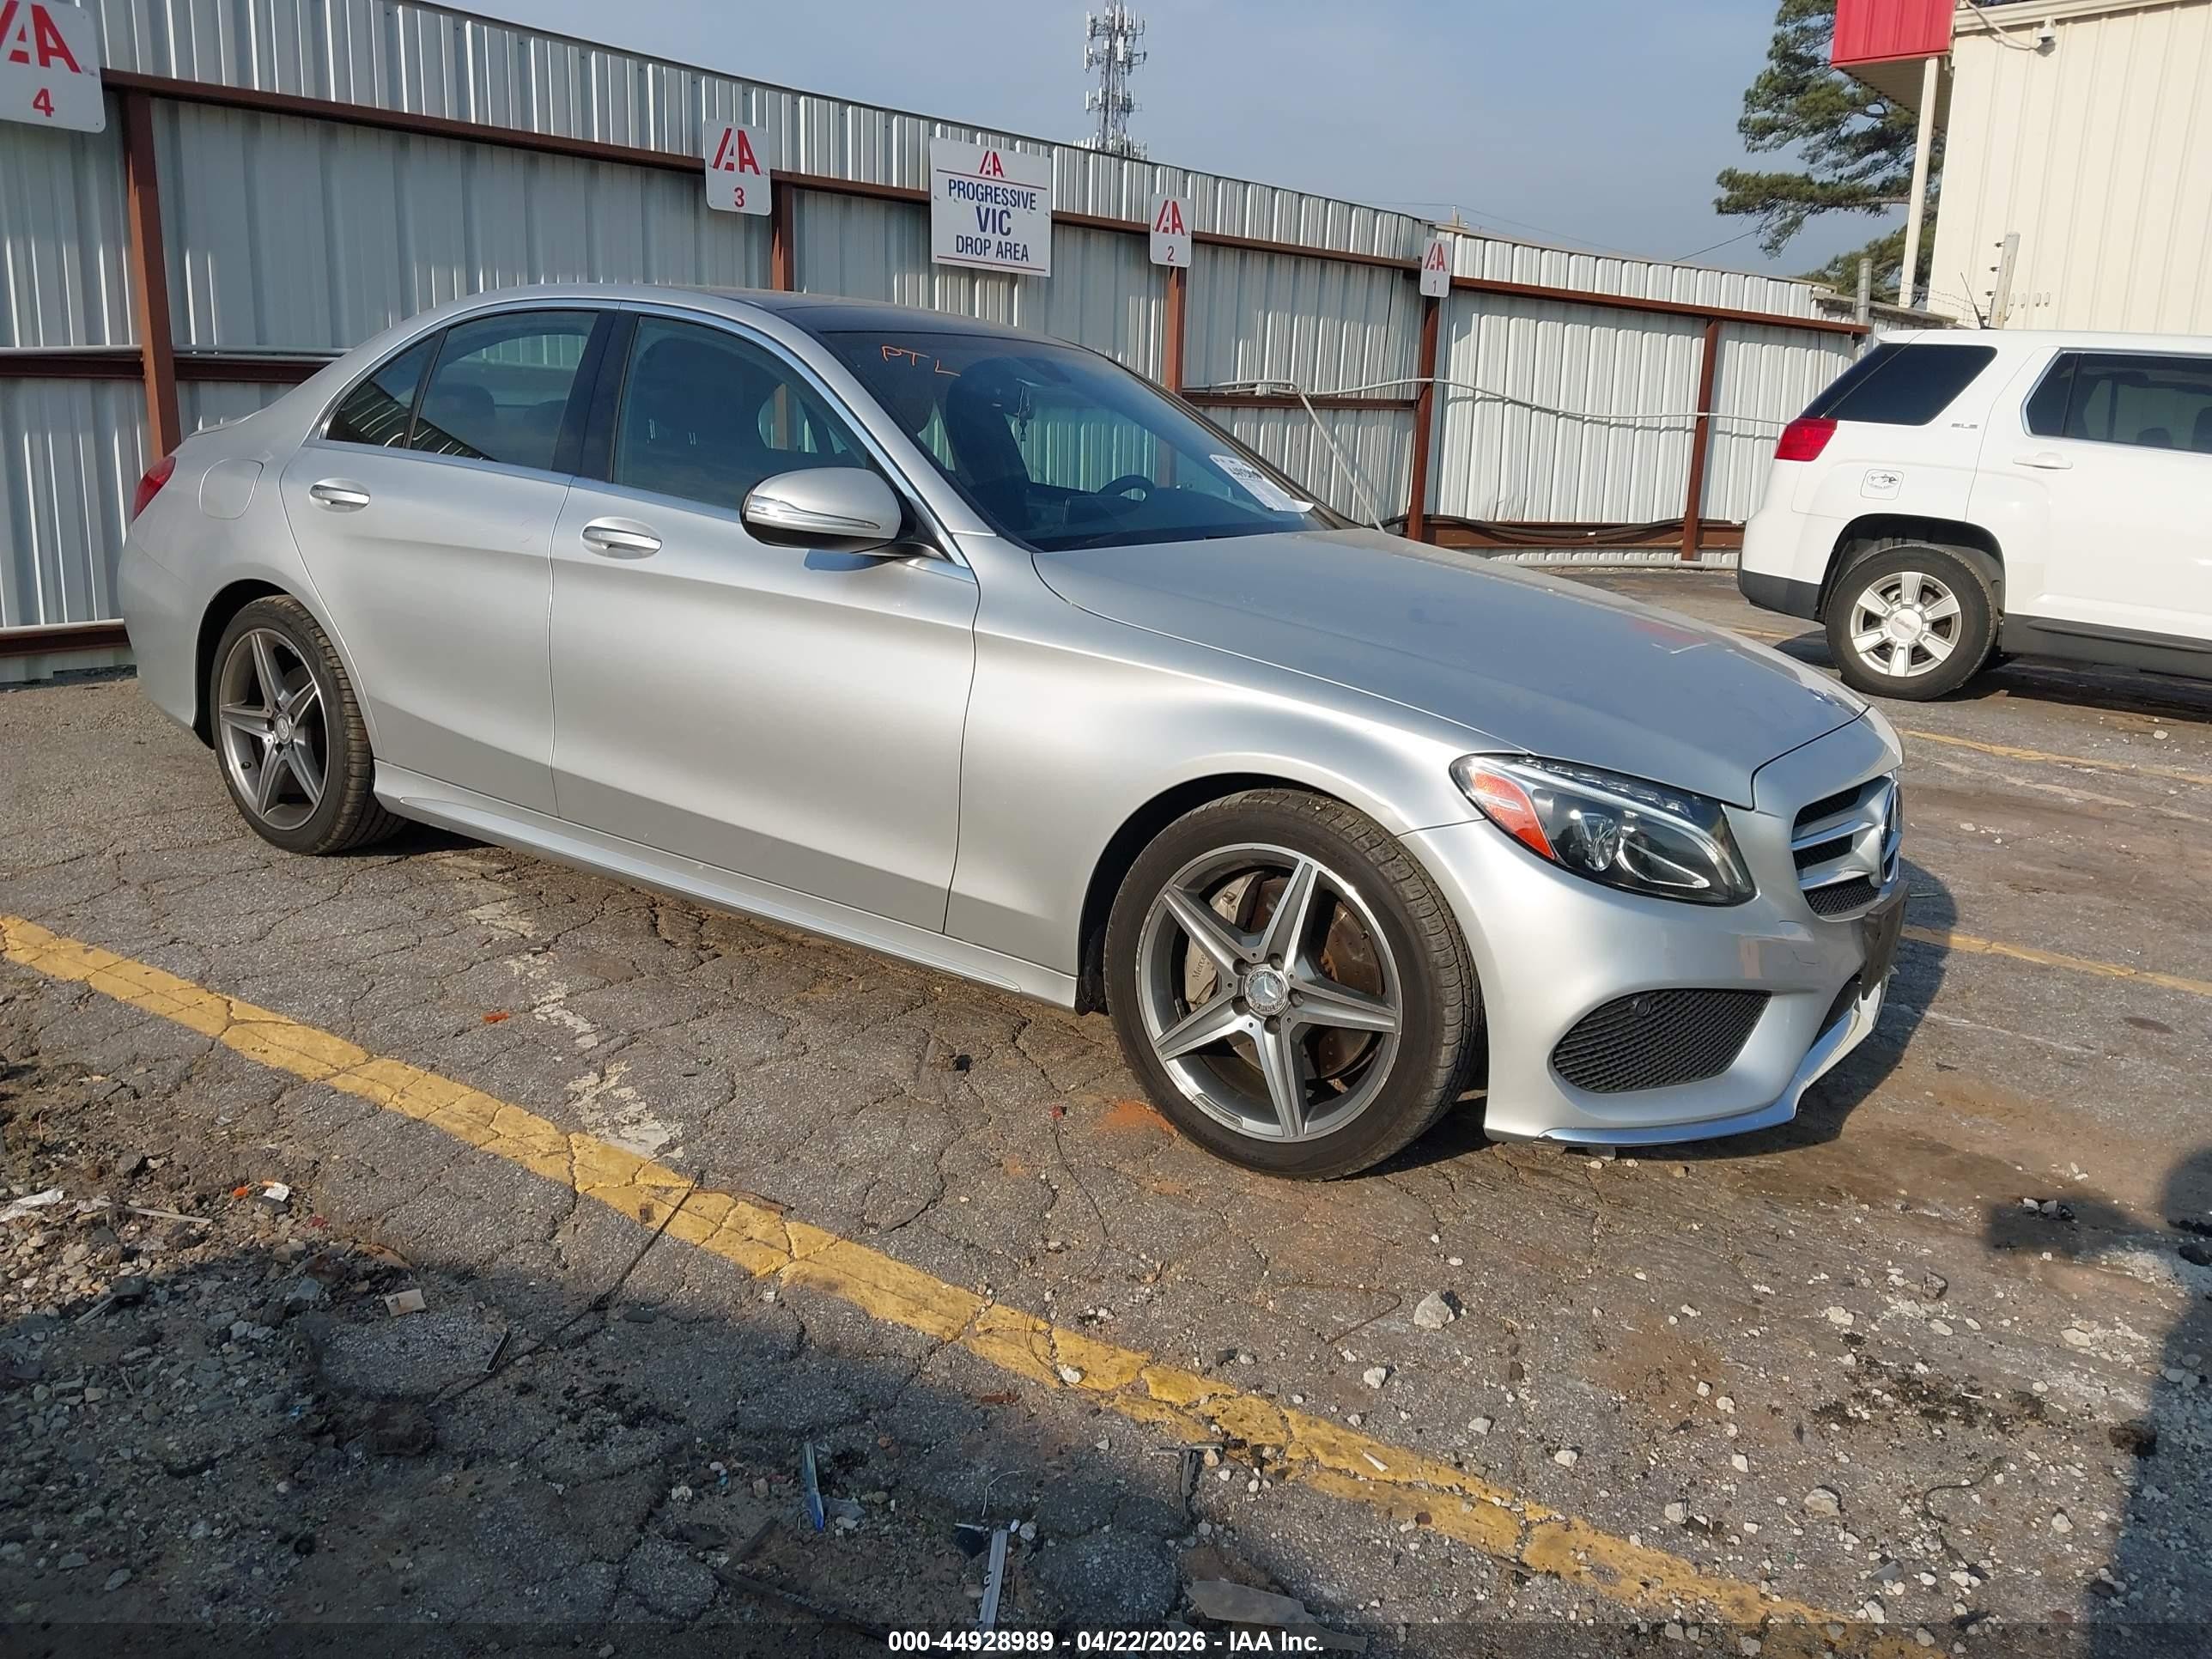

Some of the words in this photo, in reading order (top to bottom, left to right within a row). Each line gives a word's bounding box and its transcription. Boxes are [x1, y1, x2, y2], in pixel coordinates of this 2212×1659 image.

[33, 88, 55, 118] 4
[733, 186, 745, 208] 3
[948, 178, 1037, 210] PROGRESSIVE
[975, 205, 1012, 236] VIC
[956, 234, 992, 257] DROP
[995, 240, 1030, 262] AREA
[1167, 245, 1175, 263] 2
[1432, 279, 1437, 295] 1
